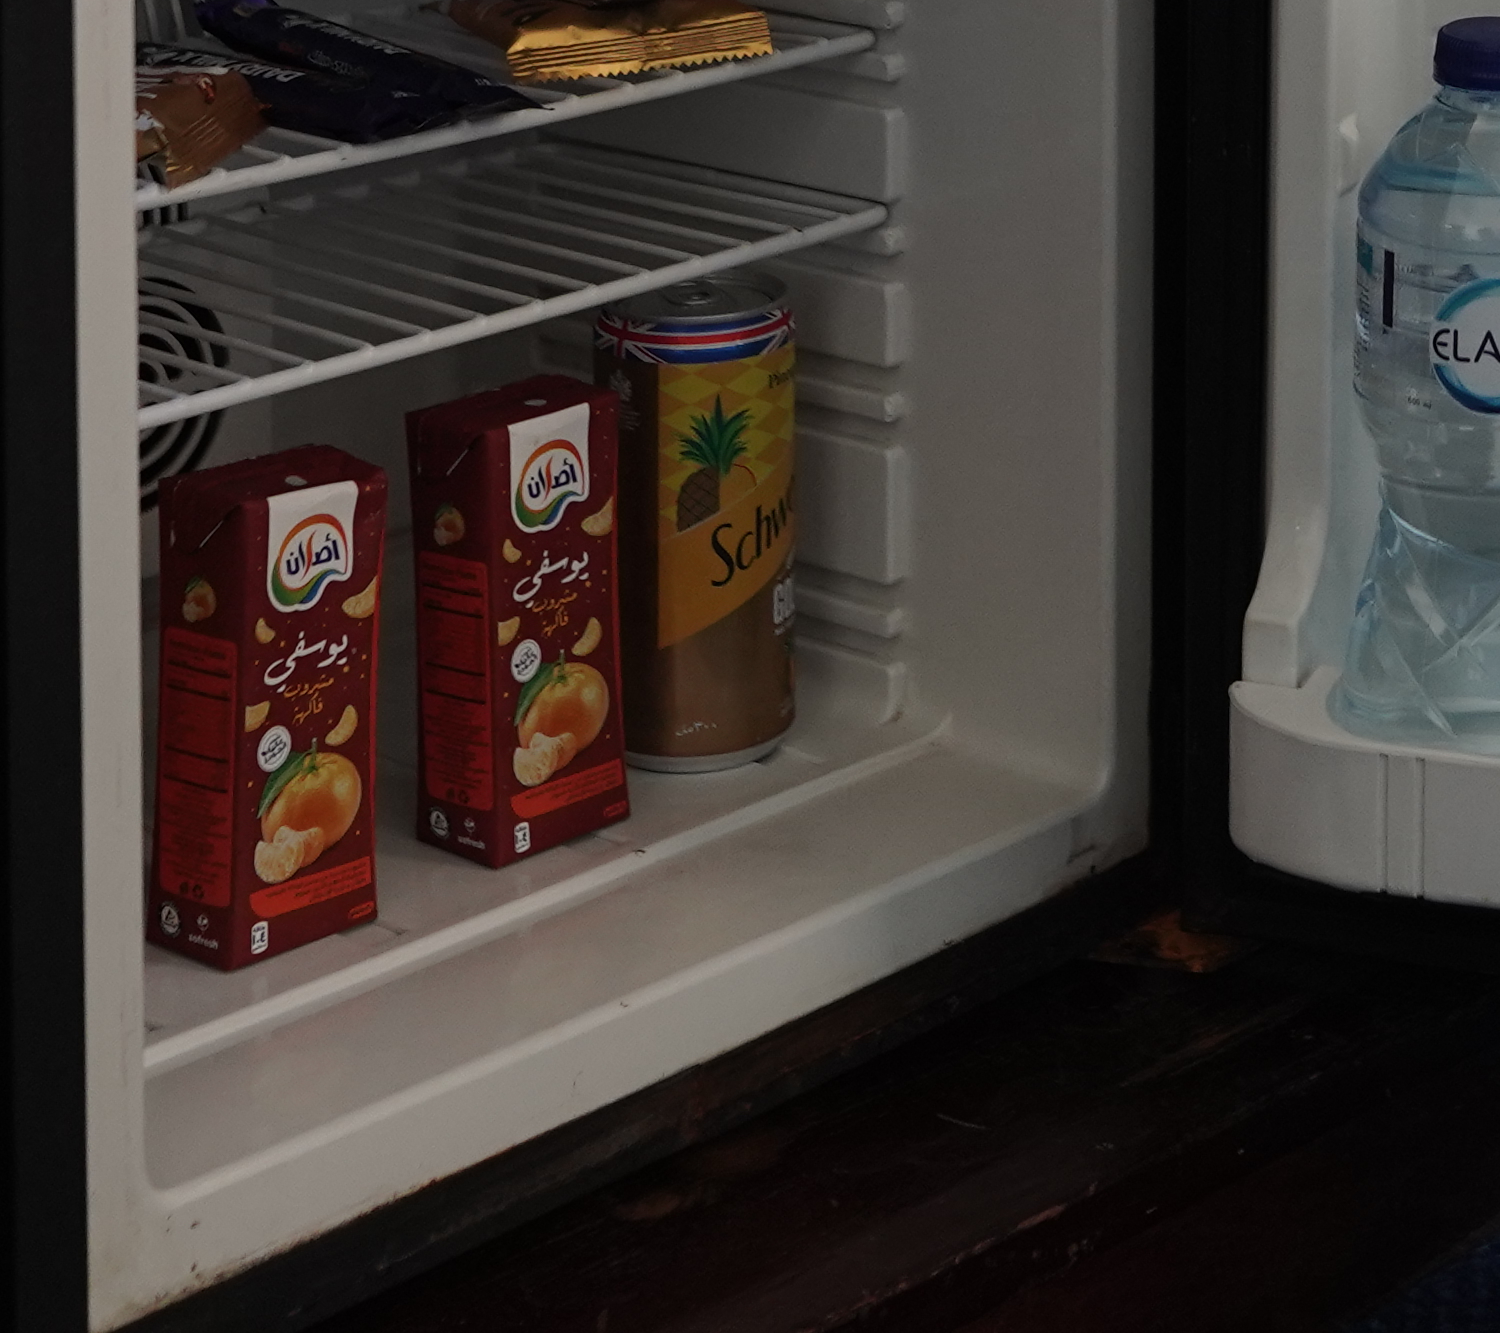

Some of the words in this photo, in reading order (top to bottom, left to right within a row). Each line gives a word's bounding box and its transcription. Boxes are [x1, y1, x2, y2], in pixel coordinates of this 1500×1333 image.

[711, 495, 790, 587] Schw
[513, 550, 589, 608] يوسفي
[264, 631, 348, 693] يوسفي
